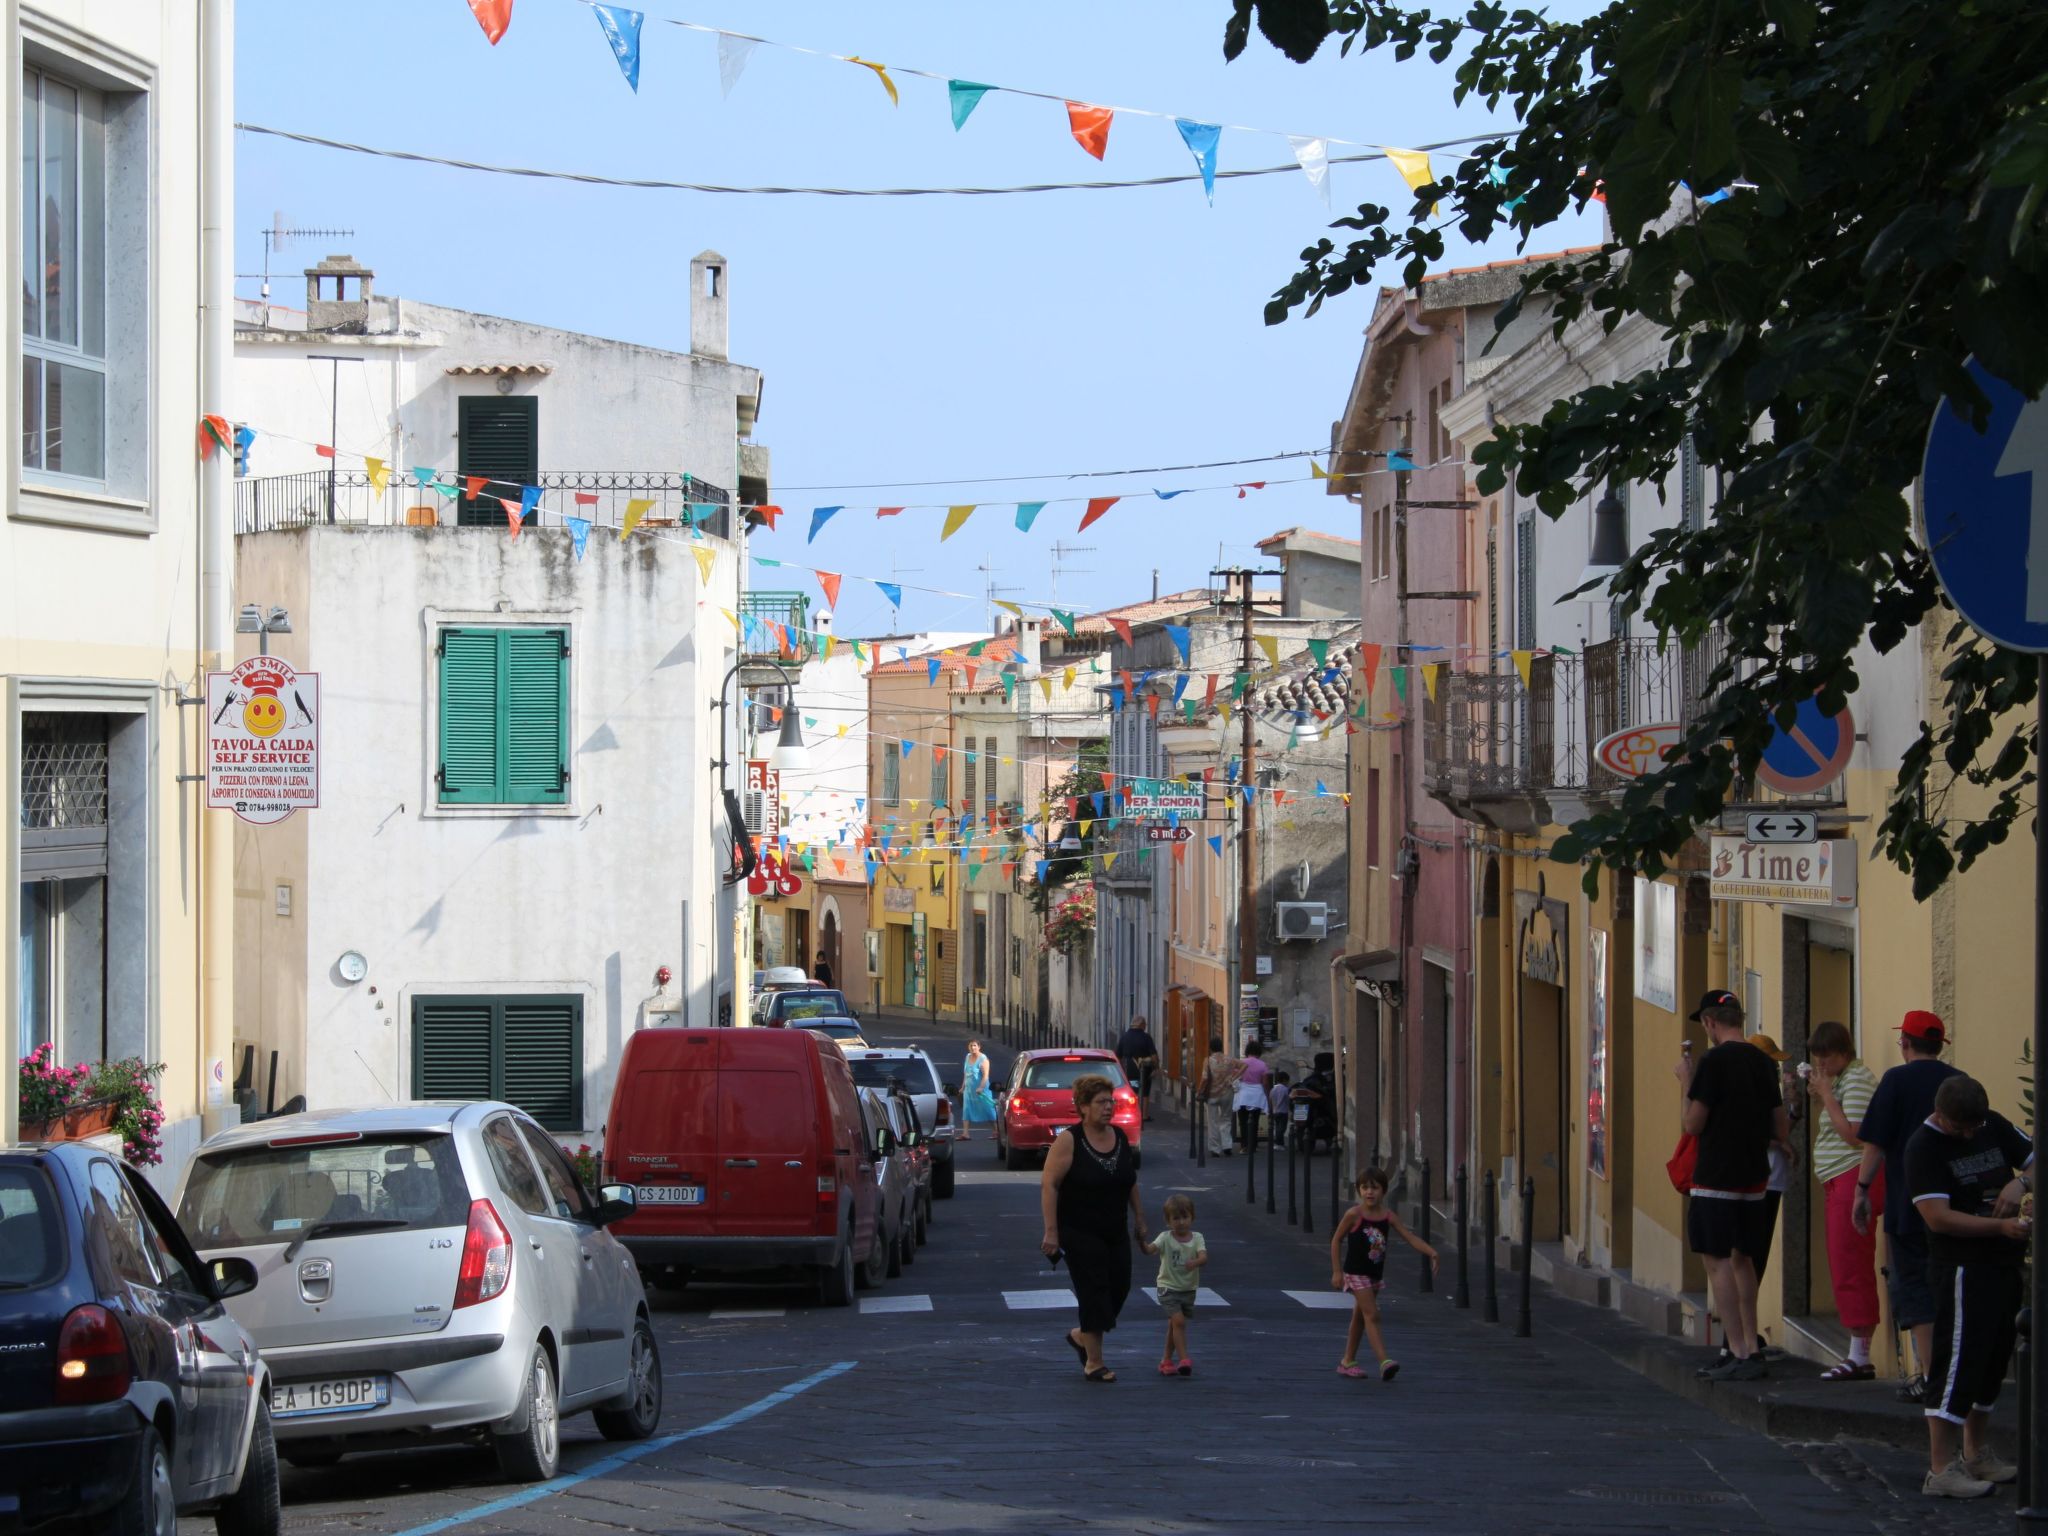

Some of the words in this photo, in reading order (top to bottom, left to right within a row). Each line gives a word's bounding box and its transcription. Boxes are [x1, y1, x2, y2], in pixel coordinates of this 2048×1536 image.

[230, 660, 254, 686] NEW
[260, 658, 297, 686] SMILE
[212, 739, 267, 751] TAVOLA
[270, 739, 314, 751] CALDA
[215, 753, 249, 763] SELF
[252, 753, 310, 763] SERVICE
[219, 776, 247, 785] PIZZERIA
[248, 776, 260, 785] CON
[261, 776, 283, 785] FORNO
[283, 776, 287, 785] A
[289, 776, 309, 785] LEGNA
[212, 788, 239, 798] ASPORTO
[240, 788, 244, 798] E
[245, 788, 276, 798] CONSEGNA
[277, 788, 282, 798] A
[283, 788, 315, 798] DOMICILIO
[1126, 797, 1148, 807] ER
[1150, 830, 1158, 839] a
[1179, 829, 1187, 839] 8
[1737, 843, 1810, 882] Time
[1713, 881, 1771, 897] CAFFETTERIA
[1779, 886, 1830, 901] GELATERIA
[640, 1188, 654, 1201] CS
[658, 1188, 697, 1201] 210DY
[0, 1342, 46, 1353] CORSA
[271, 1386, 297, 1410] EA
[309, 1379, 373, 1407] 169DP
